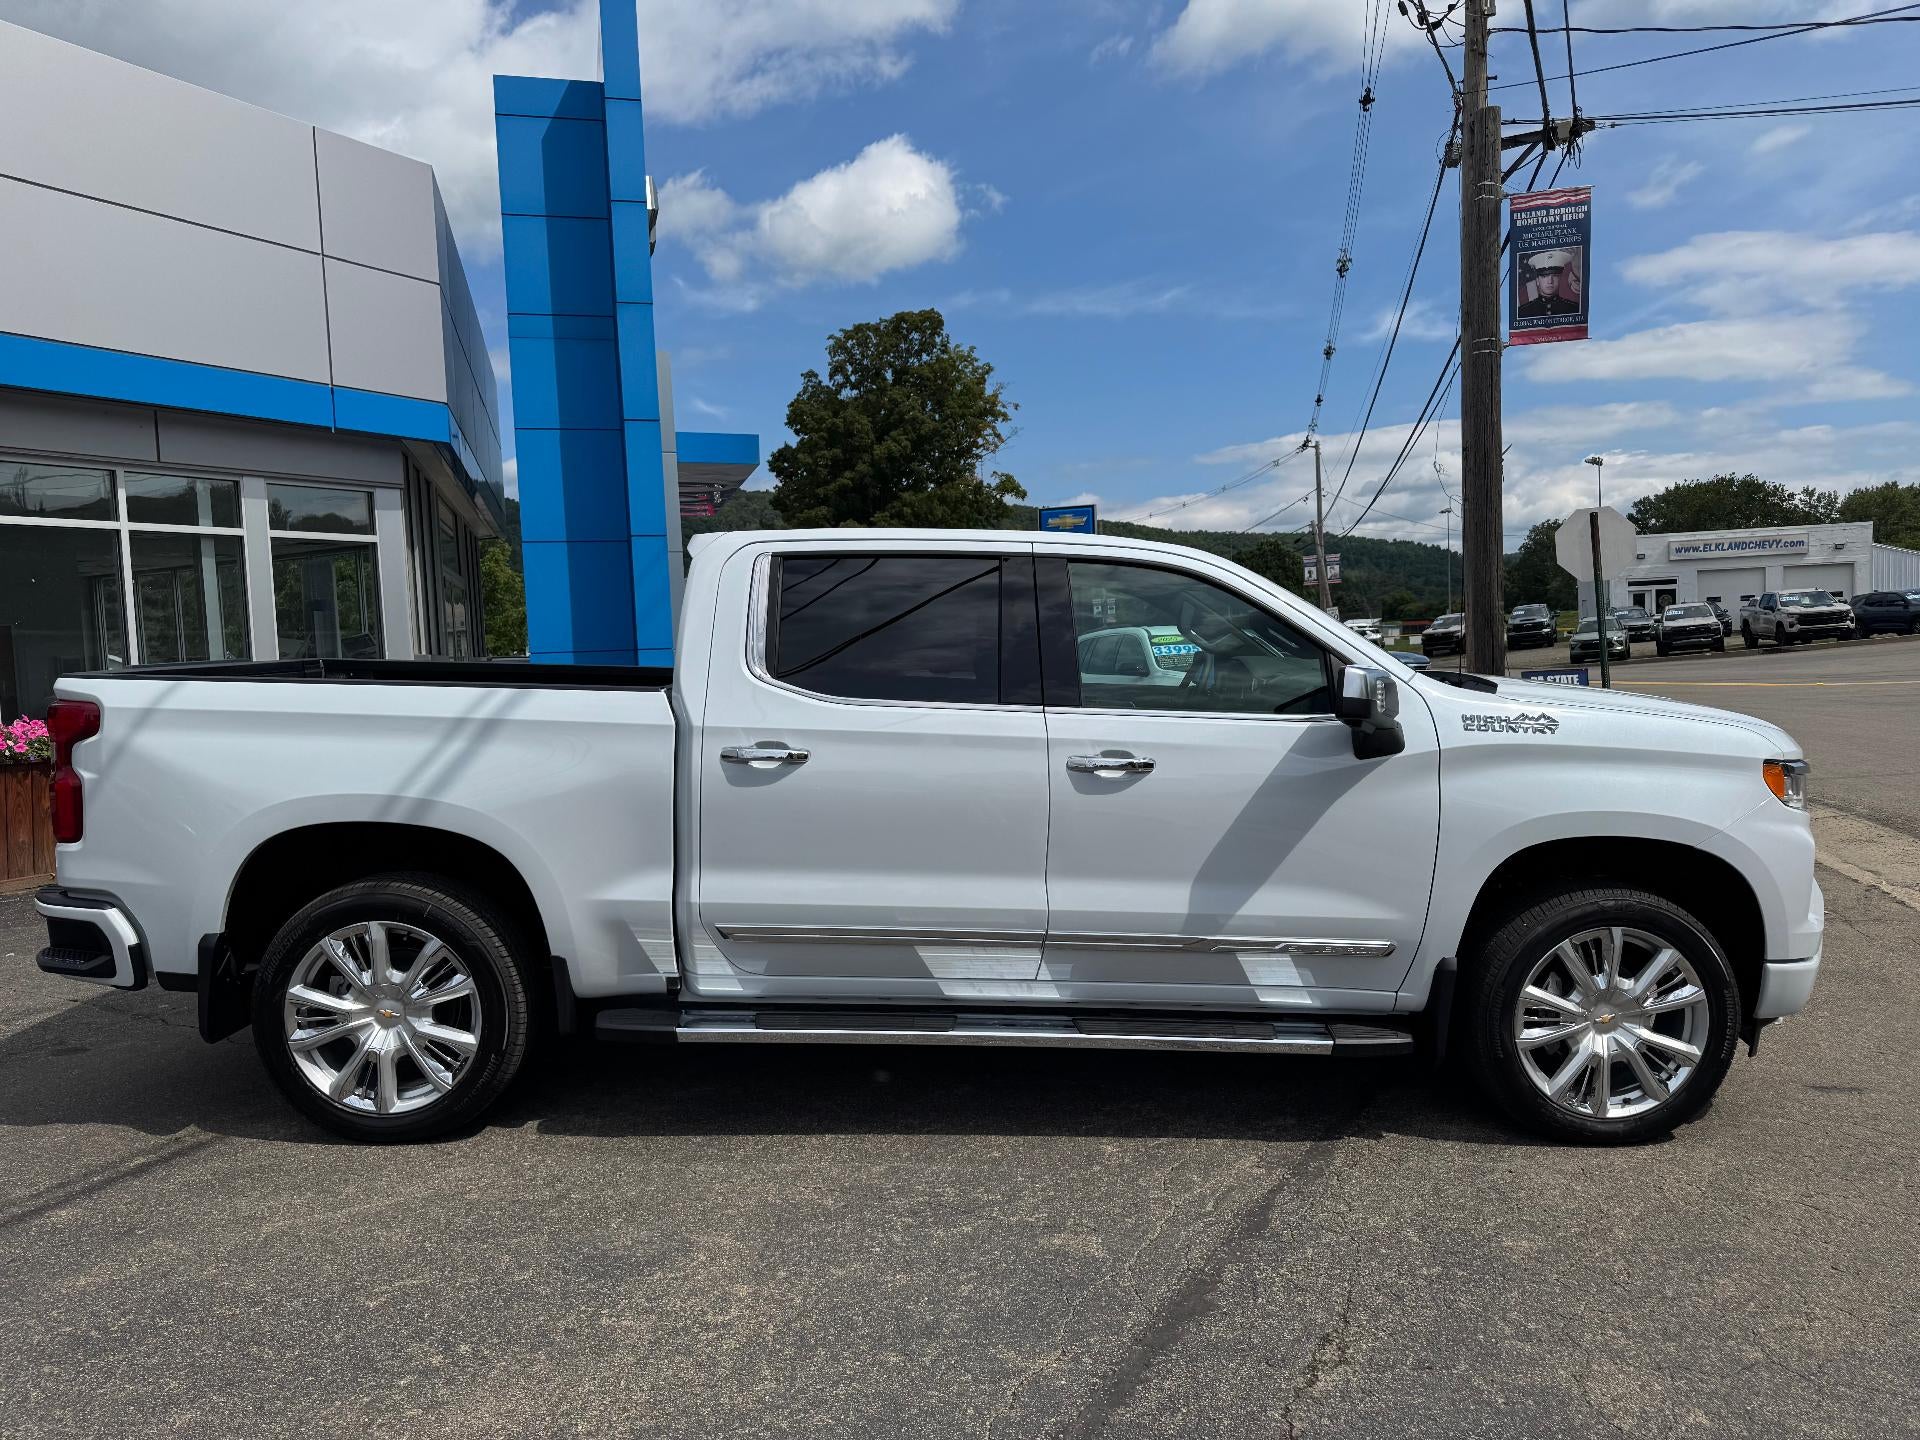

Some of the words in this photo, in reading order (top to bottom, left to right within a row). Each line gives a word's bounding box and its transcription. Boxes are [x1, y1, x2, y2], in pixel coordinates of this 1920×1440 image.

[1513, 209, 1547, 220] ELKLAND
[1549, 205, 1588, 216] BOROUGH
[1516, 215, 1560, 227] HOMETOWN
[1562, 213, 1585, 222] HERO
[1522, 230, 1554, 240] MICHAEL
[1554, 227, 1577, 236] PLANK
[1531, 238, 1557, 247] MARINE
[1559, 235, 1582, 244] CORPS
[1674, 539, 1805, 554] www.ELKLANDCHEVY.com
[1461, 713, 1511, 724] HIGH
[1462, 722, 1560, 734] COUNTRY
